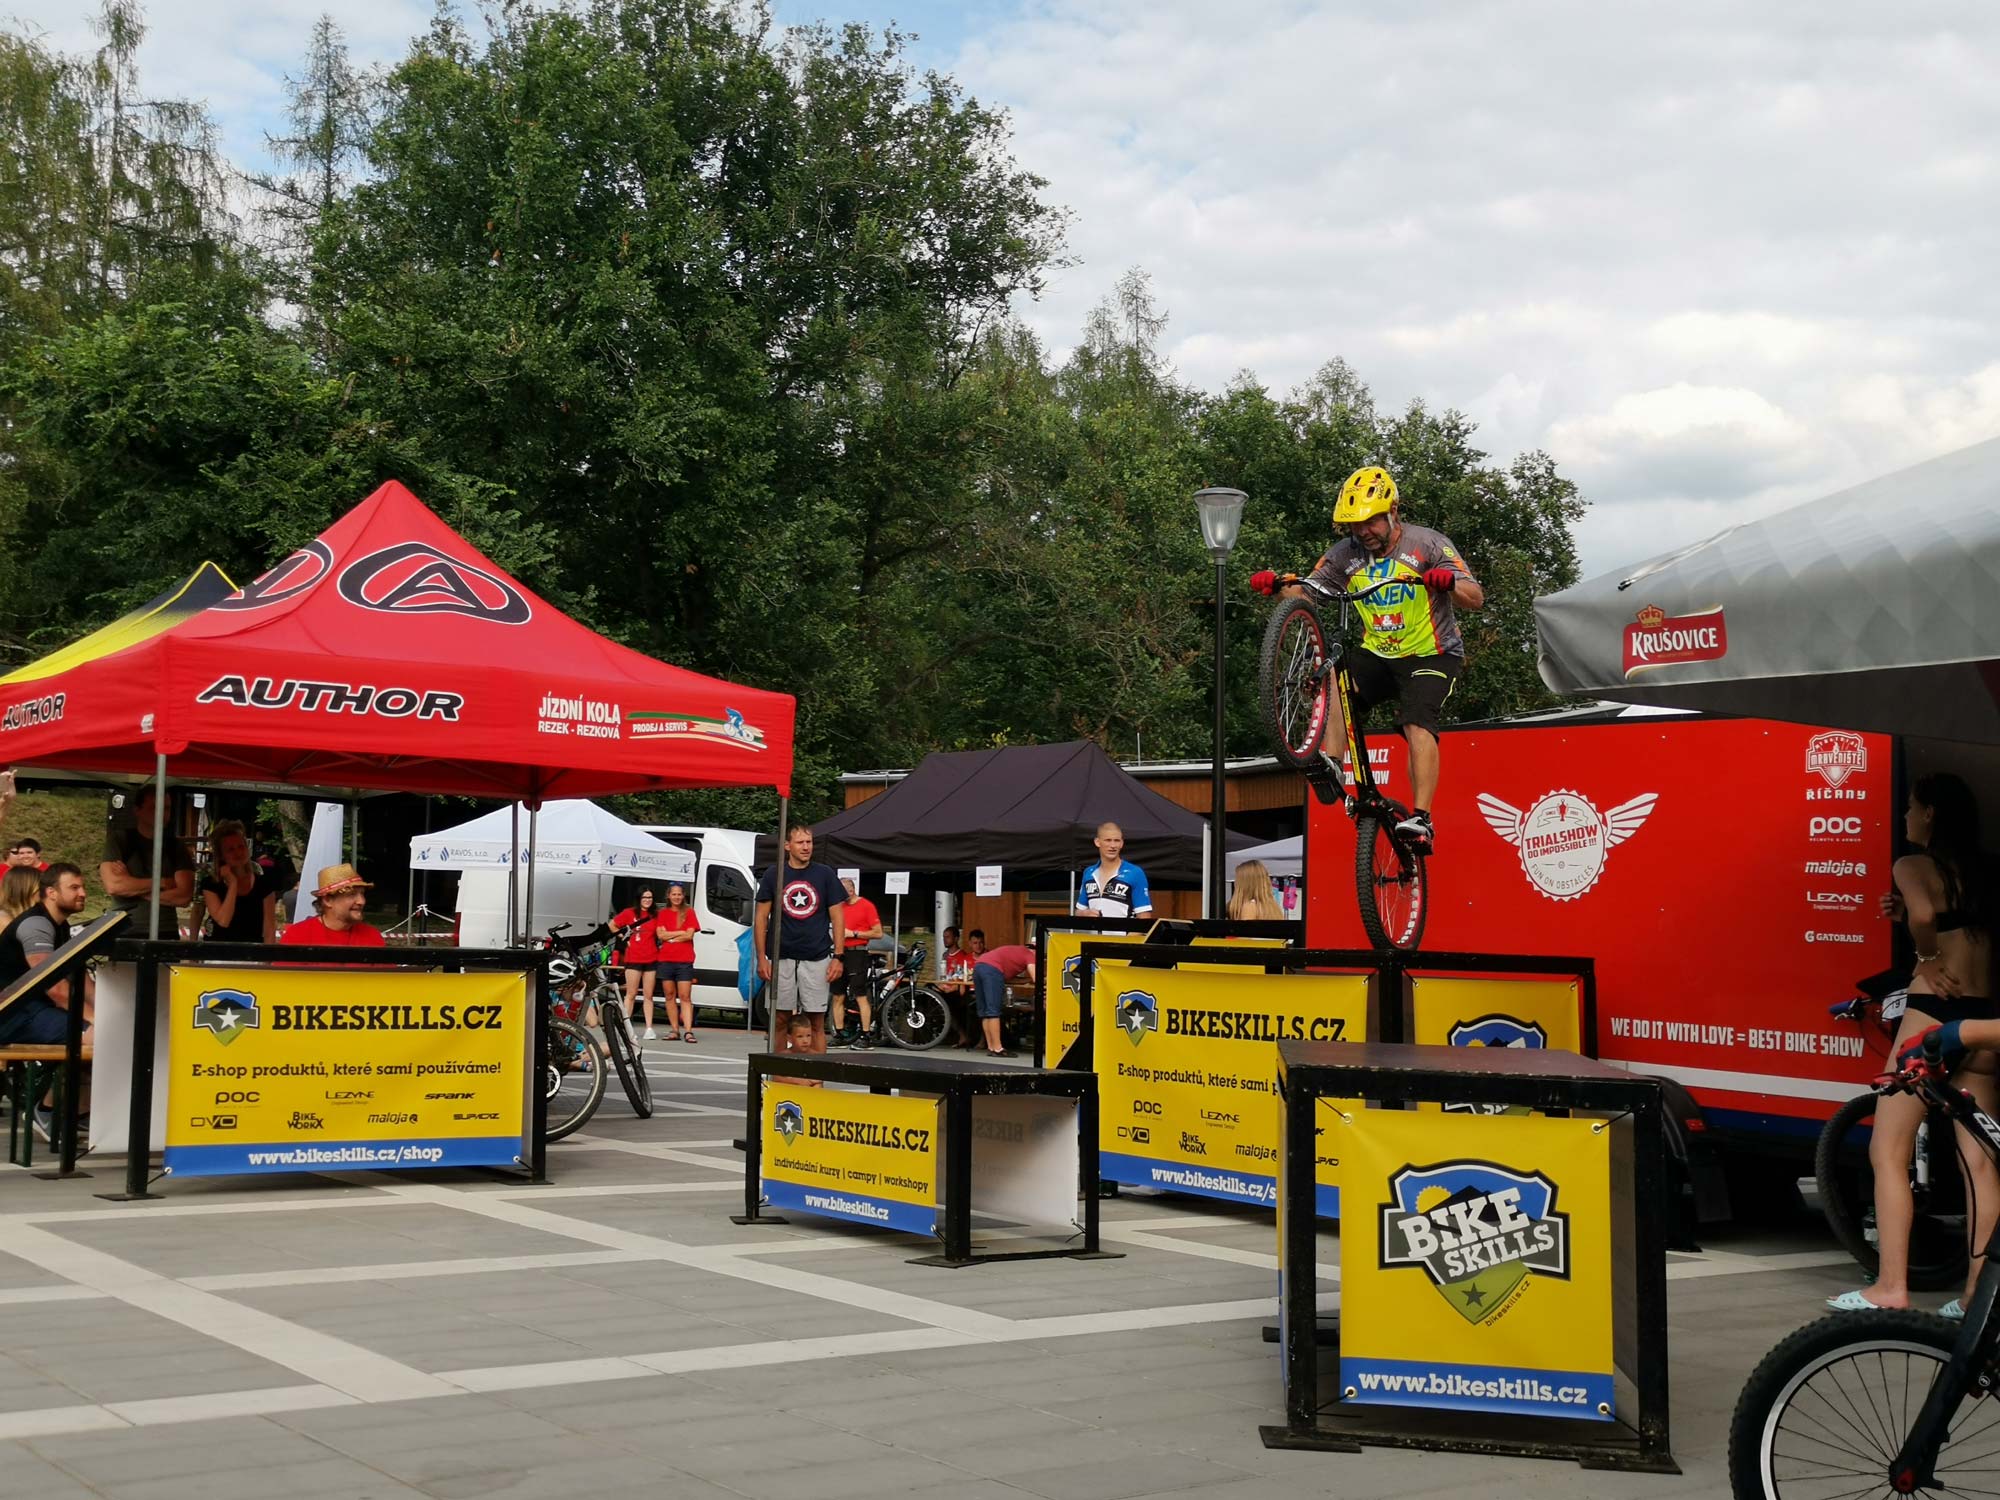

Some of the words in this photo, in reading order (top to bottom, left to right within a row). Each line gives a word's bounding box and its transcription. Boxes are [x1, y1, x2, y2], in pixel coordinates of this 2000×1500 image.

[196, 675, 464, 721] AUTHOR
[538, 691, 584, 721] JÍZDNÍ
[586, 701, 621, 724] KOLA
[1, 692, 66, 731] AUTHOR
[538, 720, 569, 734] REZEK
[577, 723, 620, 739] REZKOVÁ
[632, 723, 658, 733] PRODEJ
[658, 723, 664, 732] A
[664, 722, 688, 732] SERVIS
[1524, 824, 1598, 850] TRIALSHOW
[536, 851, 555, 859] AVOS,
[1527, 850, 1539, 859] DO
[1540, 840, 1587, 856] IMPOSSIBLE
[1531, 864, 1544, 880] FUN
[1544, 876, 1554, 888] ON
[1556, 865, 1595, 890] OBSTACLES
[1805, 860, 1853, 876] maloja
[1807, 891, 1864, 903] LEZYNE
[1816, 933, 1864, 943] GATORADE
[272, 1005, 502, 1031] BIKESKILLS.CZ
[1166, 1008, 1347, 1042] BIKESKILLS.CZ
[1611, 1017, 1630, 1037] WE
[1633, 1019, 1650, 1039] DO
[1652, 1021, 1664, 1040] IT
[1666, 1022, 1699, 1043] WITH
[1702, 1025, 1734, 1046] LOVE
[1749, 1029, 1782, 1050] BEST
[1785, 1032, 1817, 1054] BIKE
[1820, 1035, 1865, 1058] SHOW
[192, 1063, 247, 1079] E-shop
[252, 1061, 329, 1079] produktů,
[333, 1062, 372, 1076] které
[416, 1059, 501, 1077] používáme!
[1118, 1063, 1150, 1082] E-shop
[1153, 1069, 1206, 1088] produktů,
[1208, 1073, 1237, 1089] které
[326, 1091, 375, 1099] LEZYNE
[287, 1118, 324, 1129] WORKX
[293, 1112, 316, 1120] BIKE
[368, 1112, 408, 1124] maloja
[1200, 1109, 1240, 1123] LEZYNE
[808, 1116, 929, 1153] BIKESKILLS.CZ
[1182, 1131, 1199, 1142] BIKE
[249, 1146, 443, 1165] www.bikeskills.cz/shop
[1179, 1140, 1207, 1155] WORKX
[1235, 1144, 1270, 1160] maloja
[774, 1156, 818, 1175] individuální
[819, 1163, 841, 1179] kurzy
[847, 1168, 877, 1185] campy
[884, 1176, 929, 1194] workshopy
[1152, 1168, 1277, 1201] www.bikeskills.cz/s
[805, 1194, 889, 1221] www.bikeskills.cz
[1397, 1187, 1530, 1260] BIKE
[1444, 1224, 1556, 1278] SKILLS
[1485, 1280, 1531, 1327] bikeskills.cz
[1358, 1372, 1588, 1404] www.bikeskills.cz
